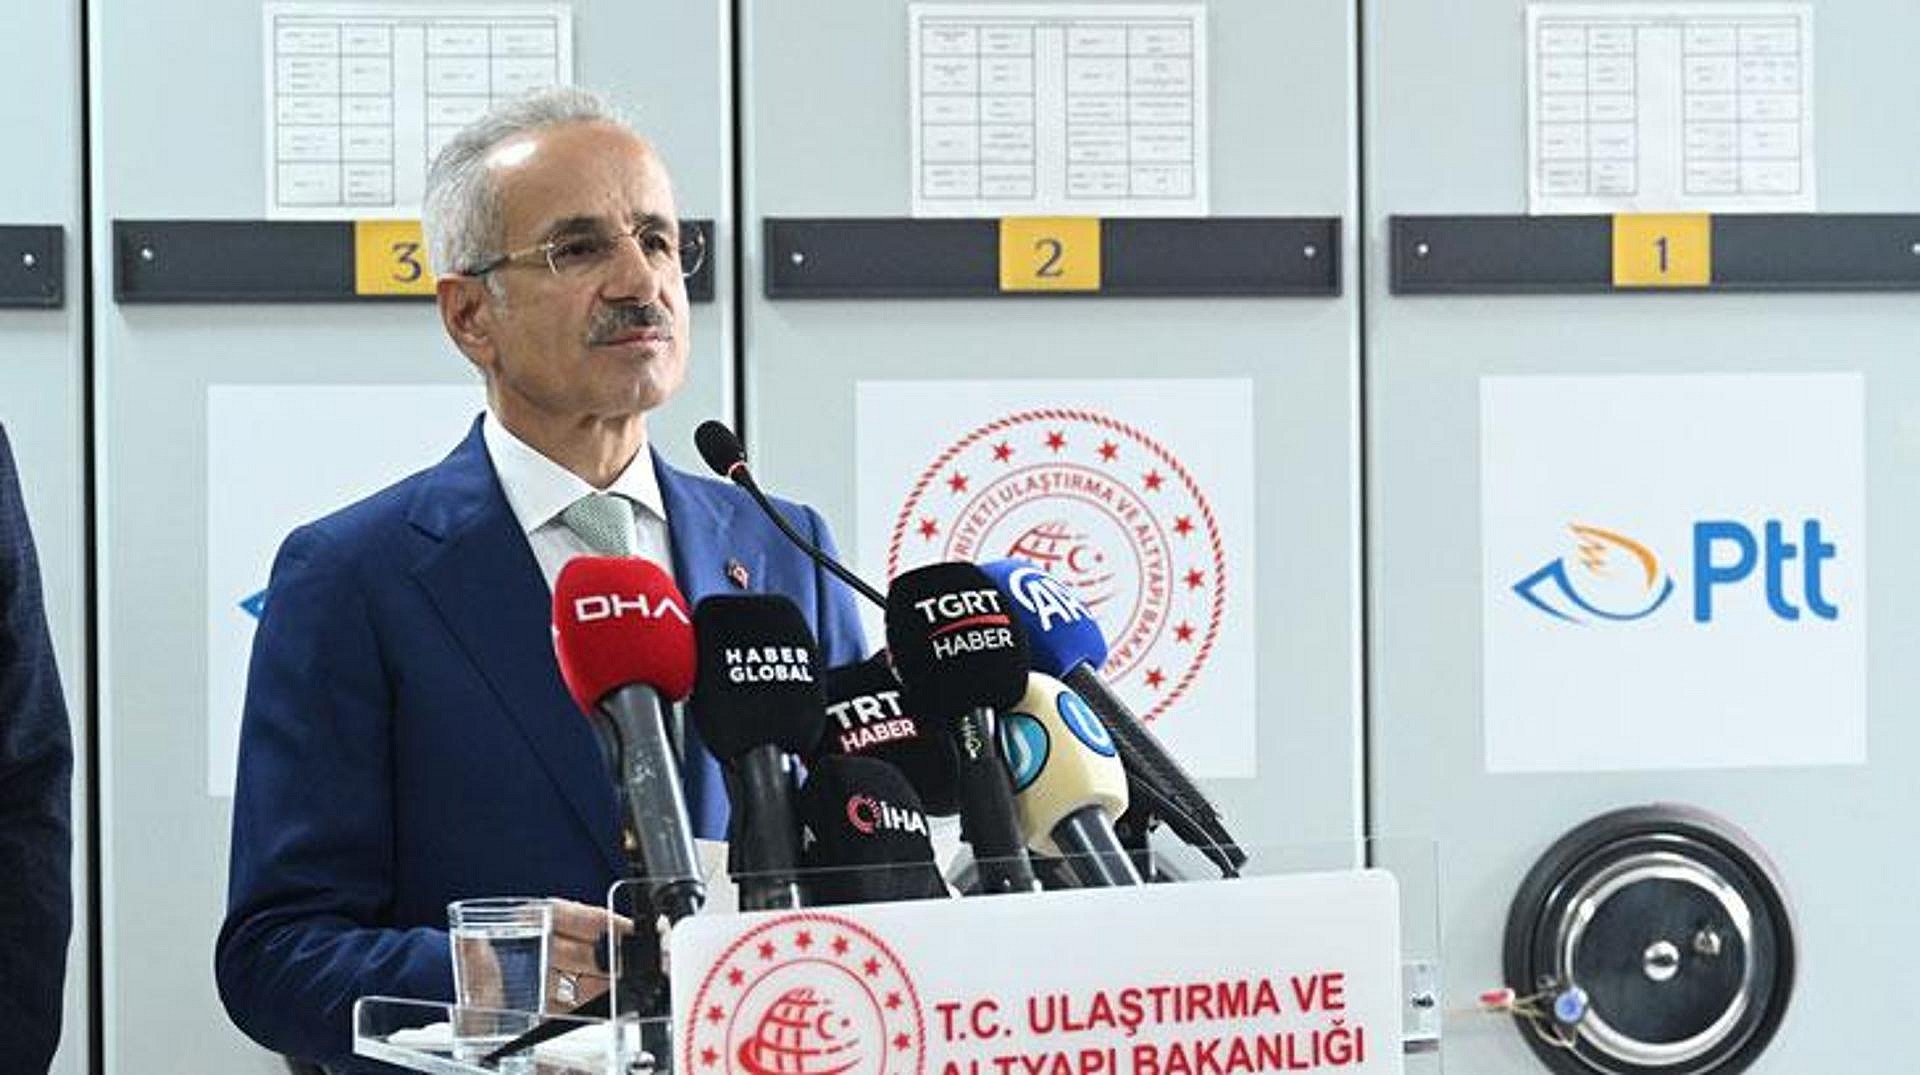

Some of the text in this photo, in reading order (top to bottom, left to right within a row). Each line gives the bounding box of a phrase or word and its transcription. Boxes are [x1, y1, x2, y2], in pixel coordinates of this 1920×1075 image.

[391, 242, 422, 283] 3
[1034, 238, 1064, 278] 2
[1655, 236, 1668, 273] 1
[1116, 497, 1139, 521] VE
[1693, 518, 1839, 623] Ptt
[574, 593, 690, 625] DHA
[914, 590, 1001, 624] TGRT
[726, 647, 810, 665] HABER
[932, 628, 1014, 660] HABER
[729, 664, 814, 683] GLOBAL
[826, 691, 902, 729] TRT
[840, 719, 917, 752] HABER
[880, 801, 927, 836] İHA
[936, 973, 1346, 1042] T.C. ULAŞTIRMA VE
[1132, 1019, 1365, 1075] BAKANLIĞI
